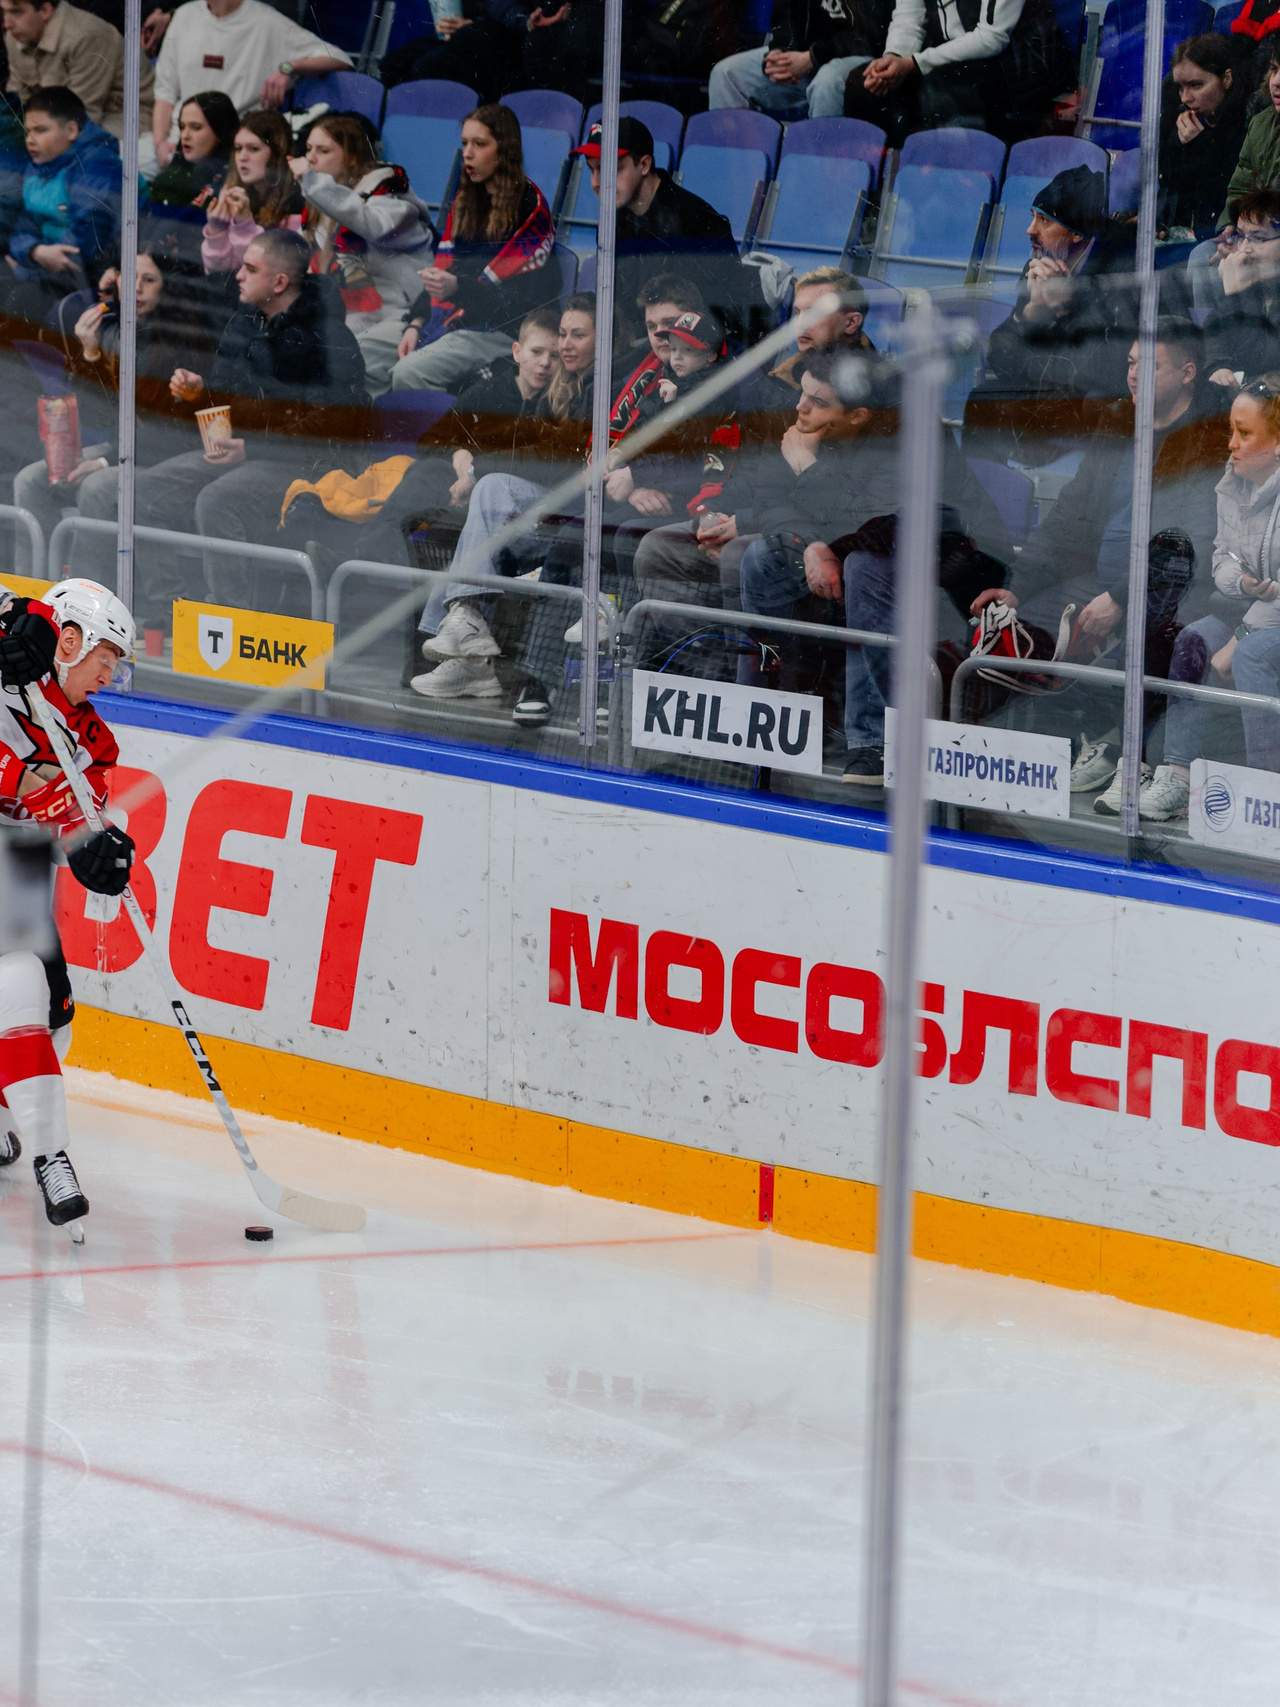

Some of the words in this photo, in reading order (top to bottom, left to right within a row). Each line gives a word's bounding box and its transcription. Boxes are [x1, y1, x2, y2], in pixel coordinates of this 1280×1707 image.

[238, 635, 308, 670] БАНК
[85, 721, 101, 743] C
[643, 685, 812, 756] KHL.RU
[927, 746, 1059, 790] ГАЗПРОМБАНК
[171, 1000, 222, 1092] CCM
